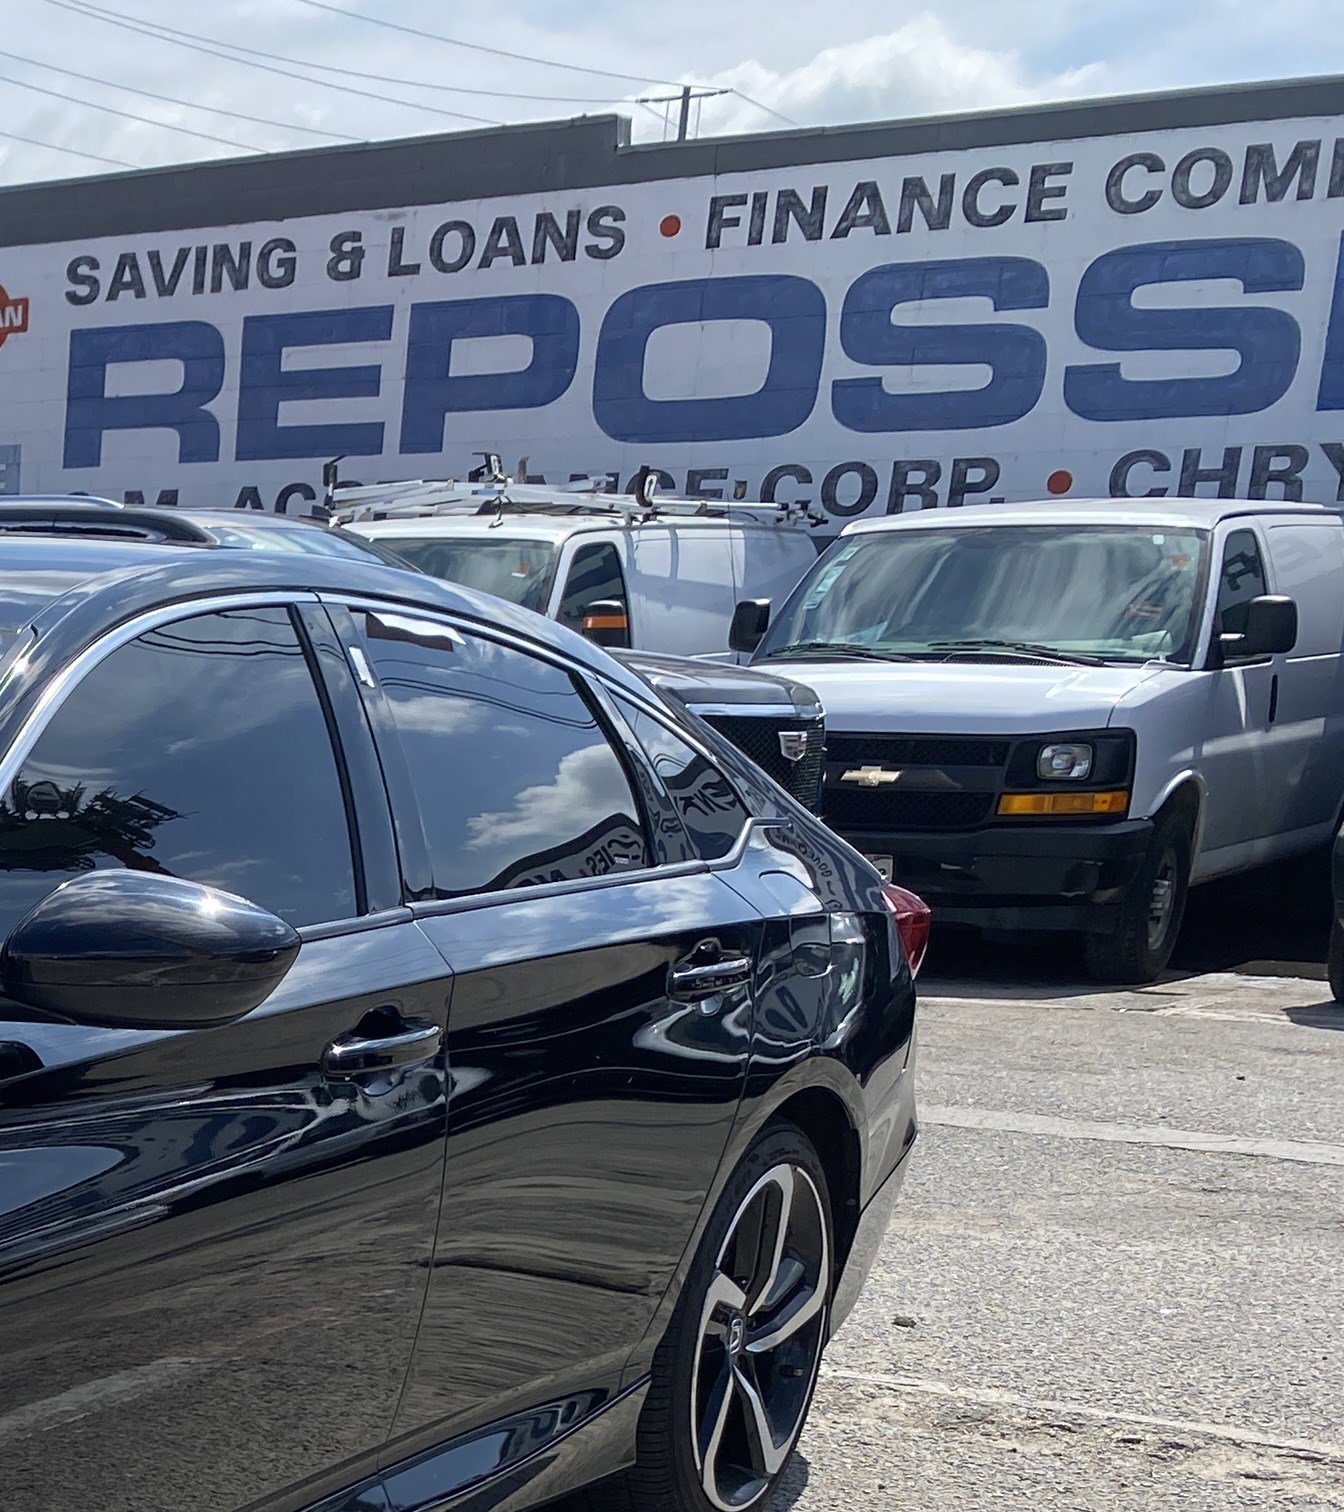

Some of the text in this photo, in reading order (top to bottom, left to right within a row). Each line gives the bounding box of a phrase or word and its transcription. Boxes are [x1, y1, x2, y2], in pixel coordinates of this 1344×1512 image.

[65, 237, 297, 306] SAVING
[326, 230, 366, 282] &
[388, 205, 627, 276] LOANS
[704, 161, 1074, 248] FINANCE
[62, 228, 1344, 470] REPOSS
